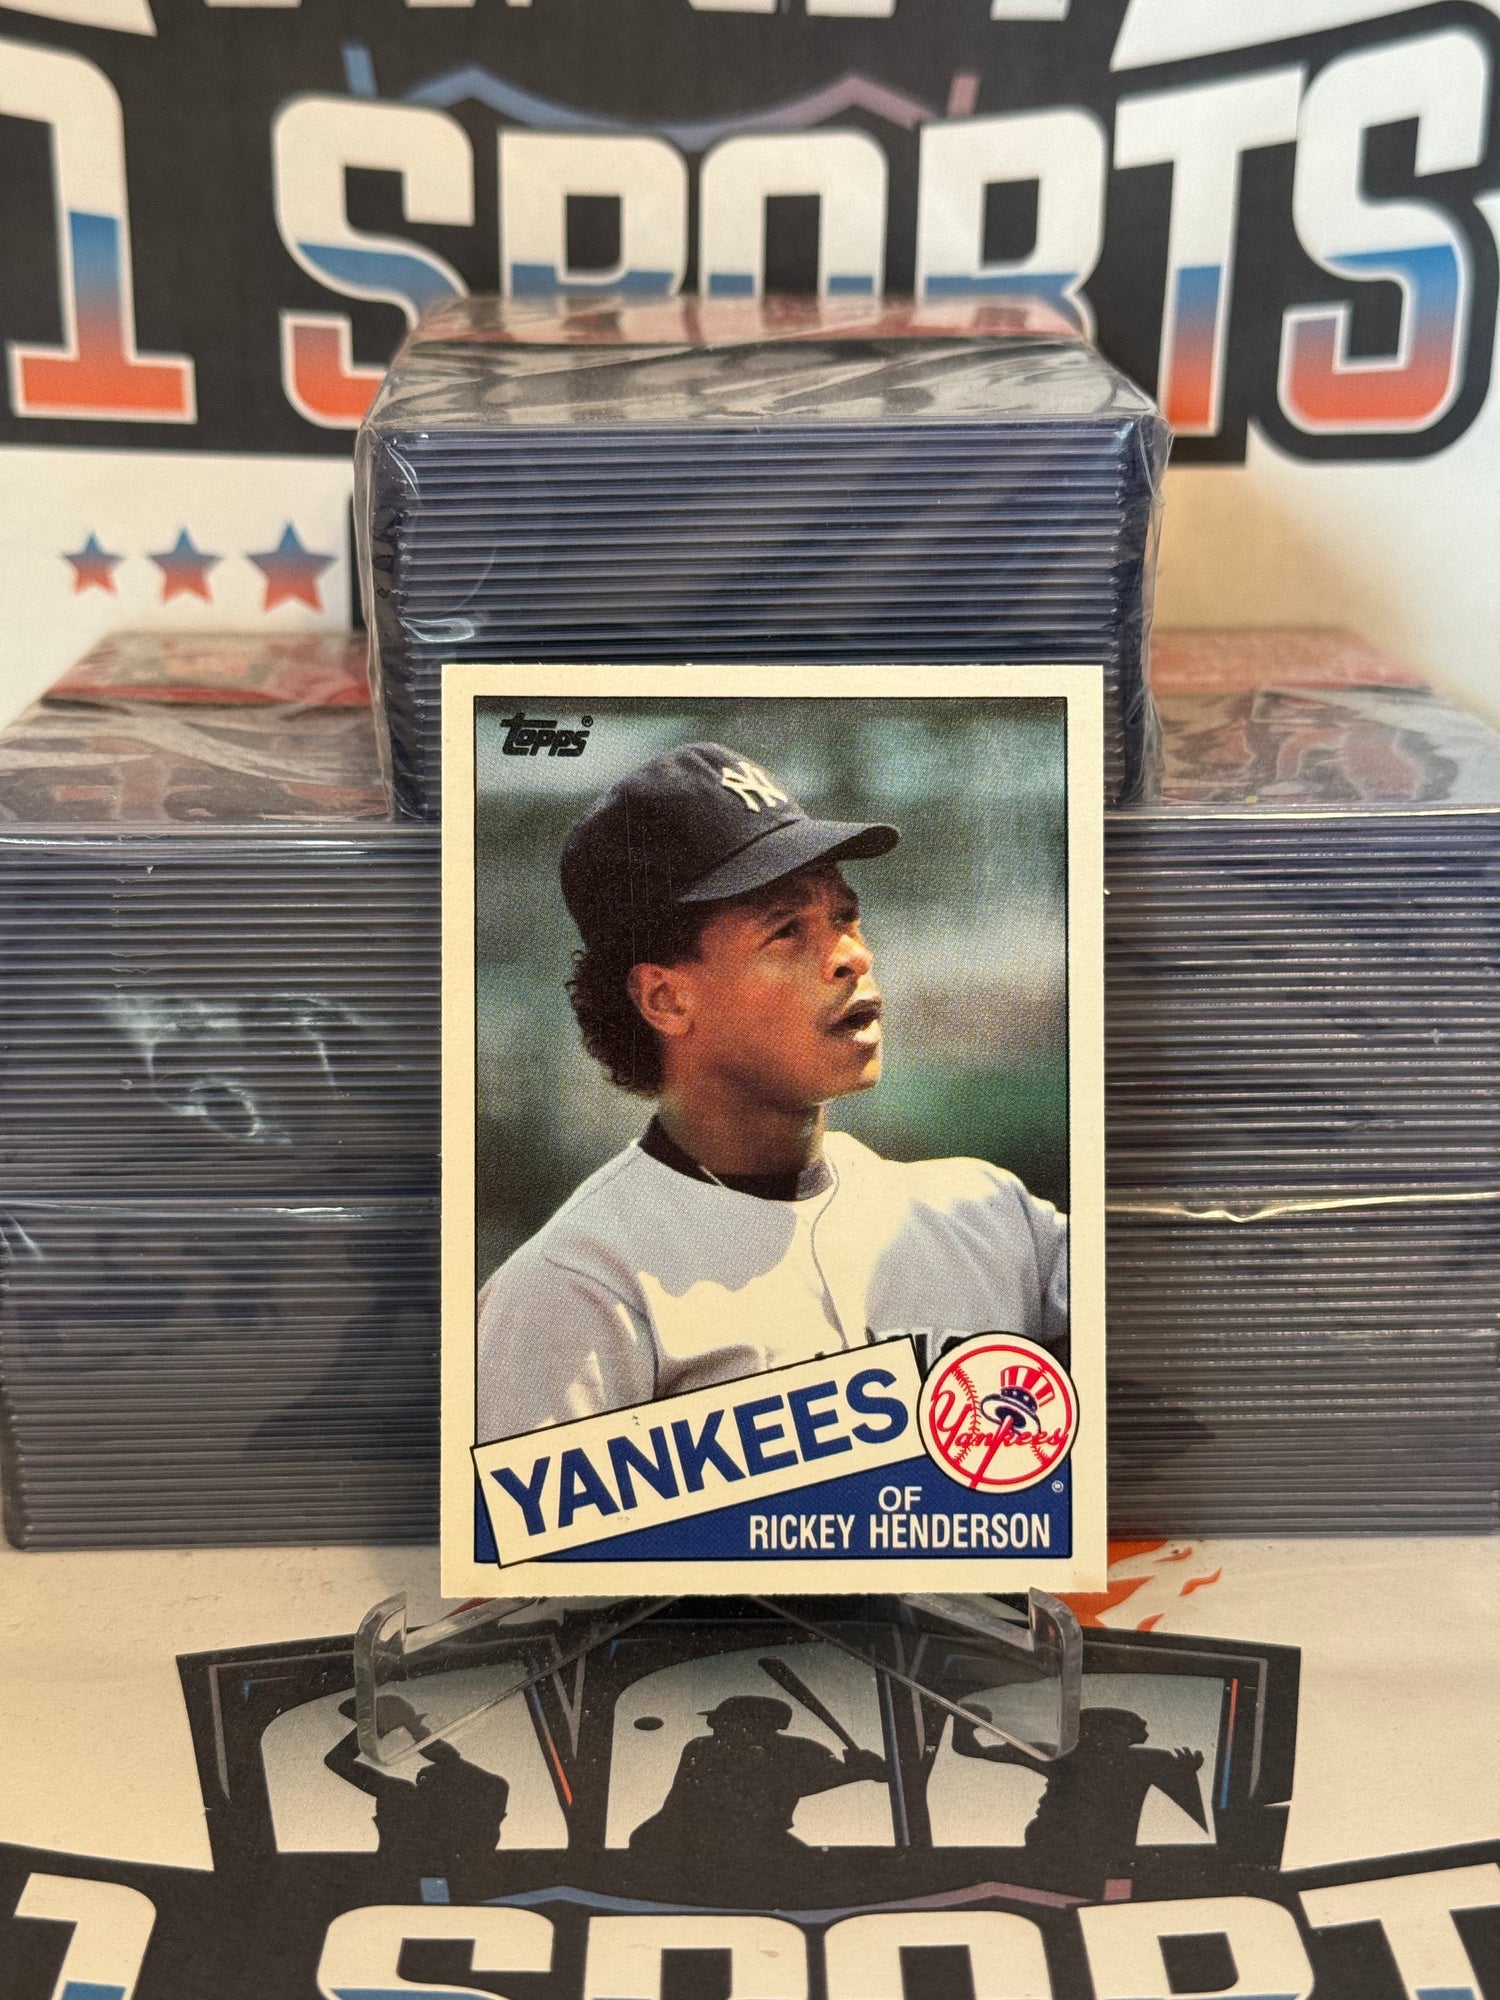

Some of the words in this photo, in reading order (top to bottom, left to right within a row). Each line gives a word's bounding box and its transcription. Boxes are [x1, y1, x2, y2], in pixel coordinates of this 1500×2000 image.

[272, 26, 1489, 435] SPORTS
[490, 1367, 910, 1537] YANKEES
[930, 1389, 1069, 1456] Yankees
[749, 1513, 856, 1550] RICKEY
[869, 1512, 1050, 1549] HENDERSON
[877, 1485, 923, 1512] OF
